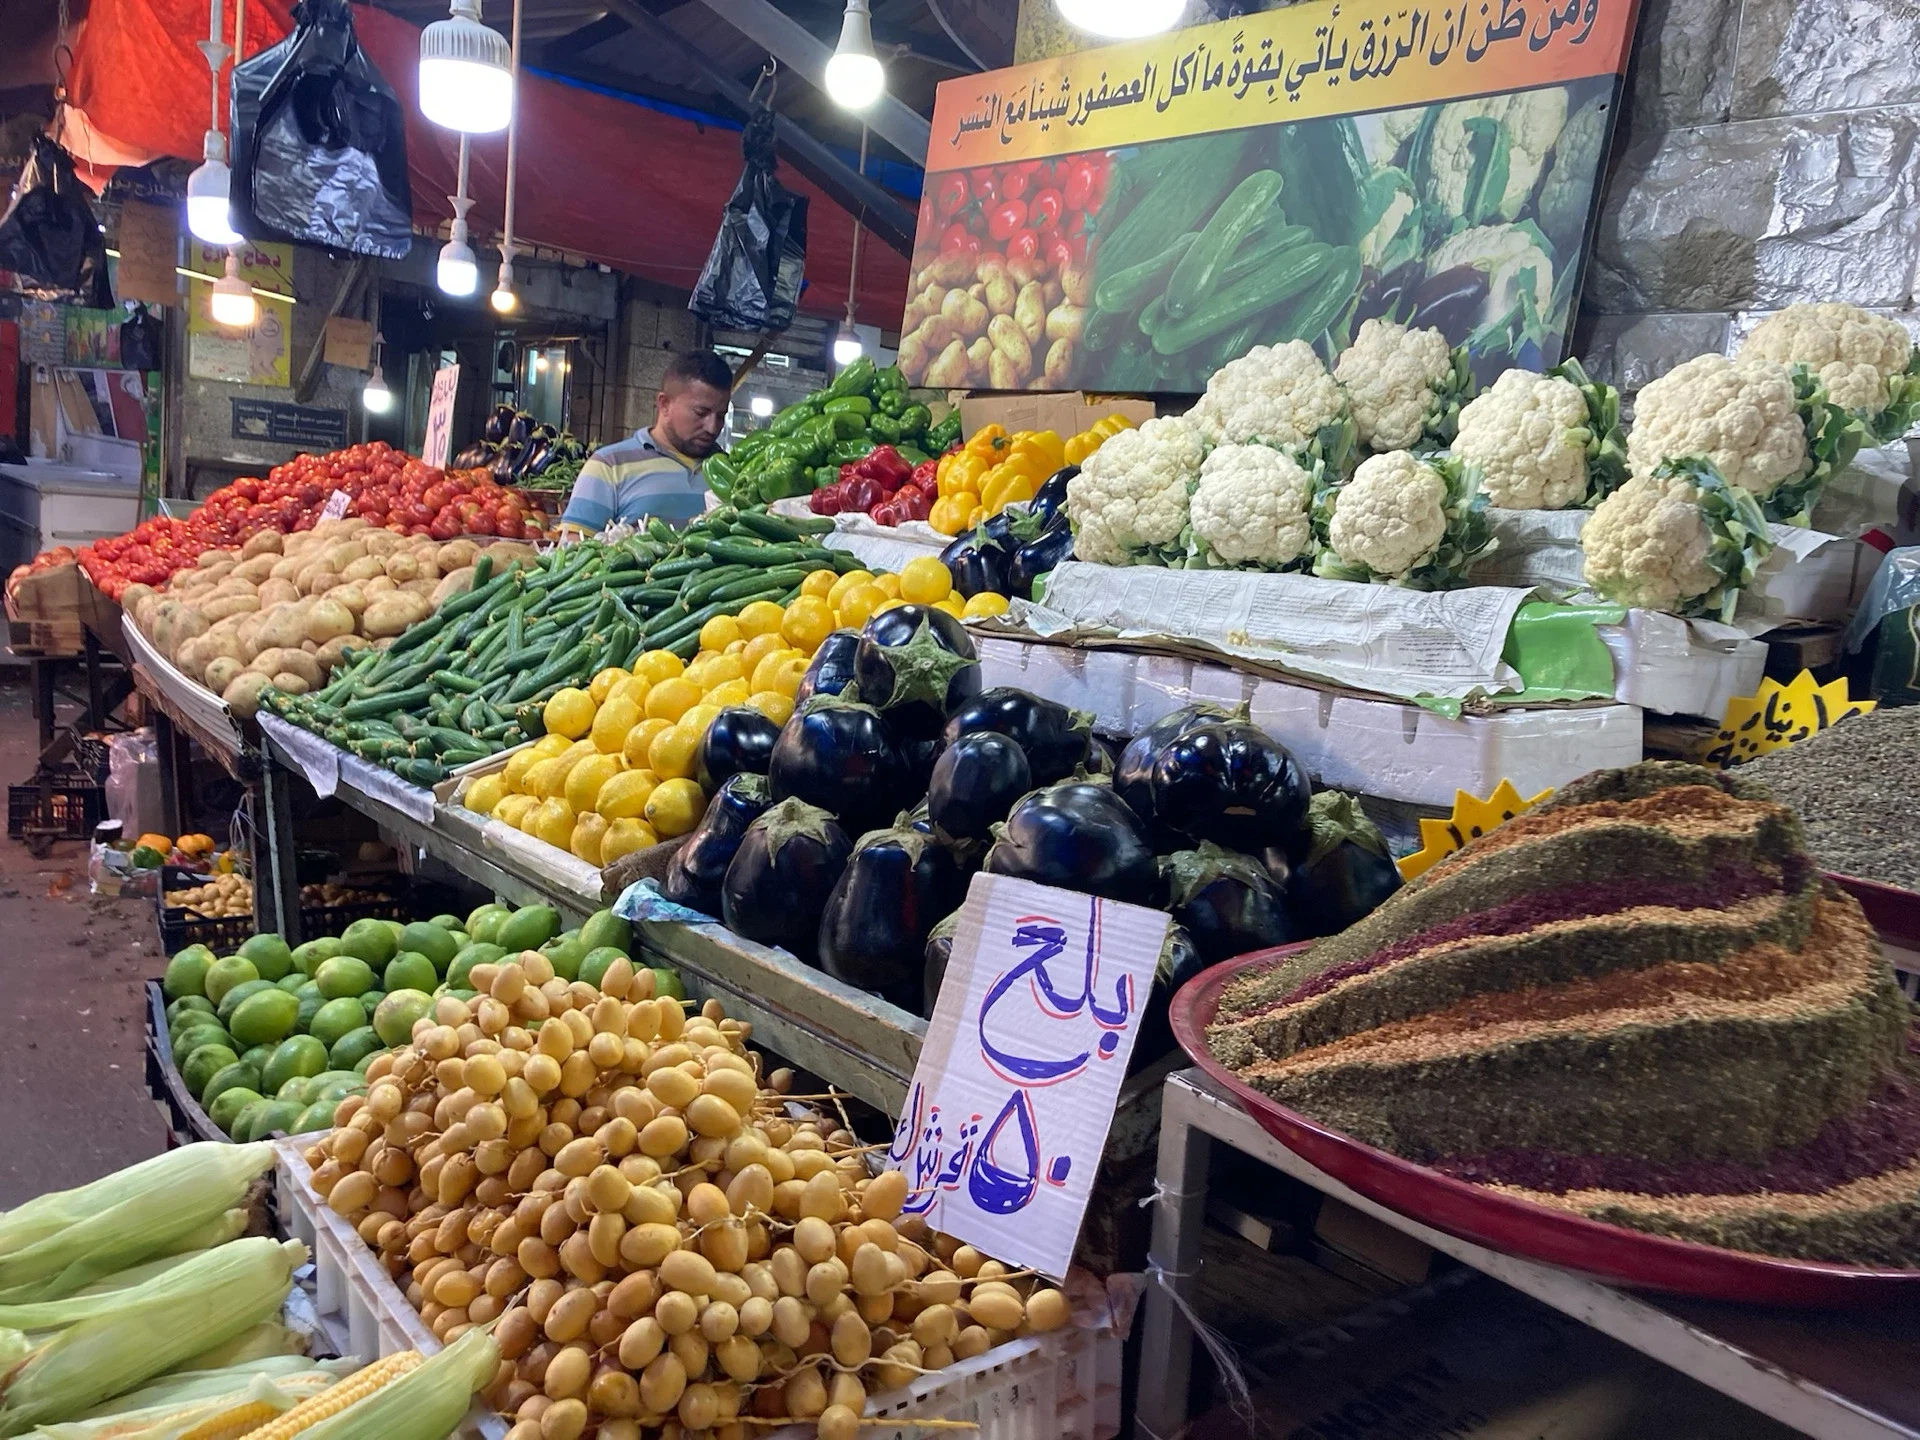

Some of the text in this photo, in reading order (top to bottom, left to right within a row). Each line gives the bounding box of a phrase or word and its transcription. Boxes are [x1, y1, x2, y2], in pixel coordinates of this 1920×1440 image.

[1067, 62, 1158, 126] العصفور
[978, 896, 1136, 1087] بلح
[968, 1089, 1073, 1214] ٥٠
